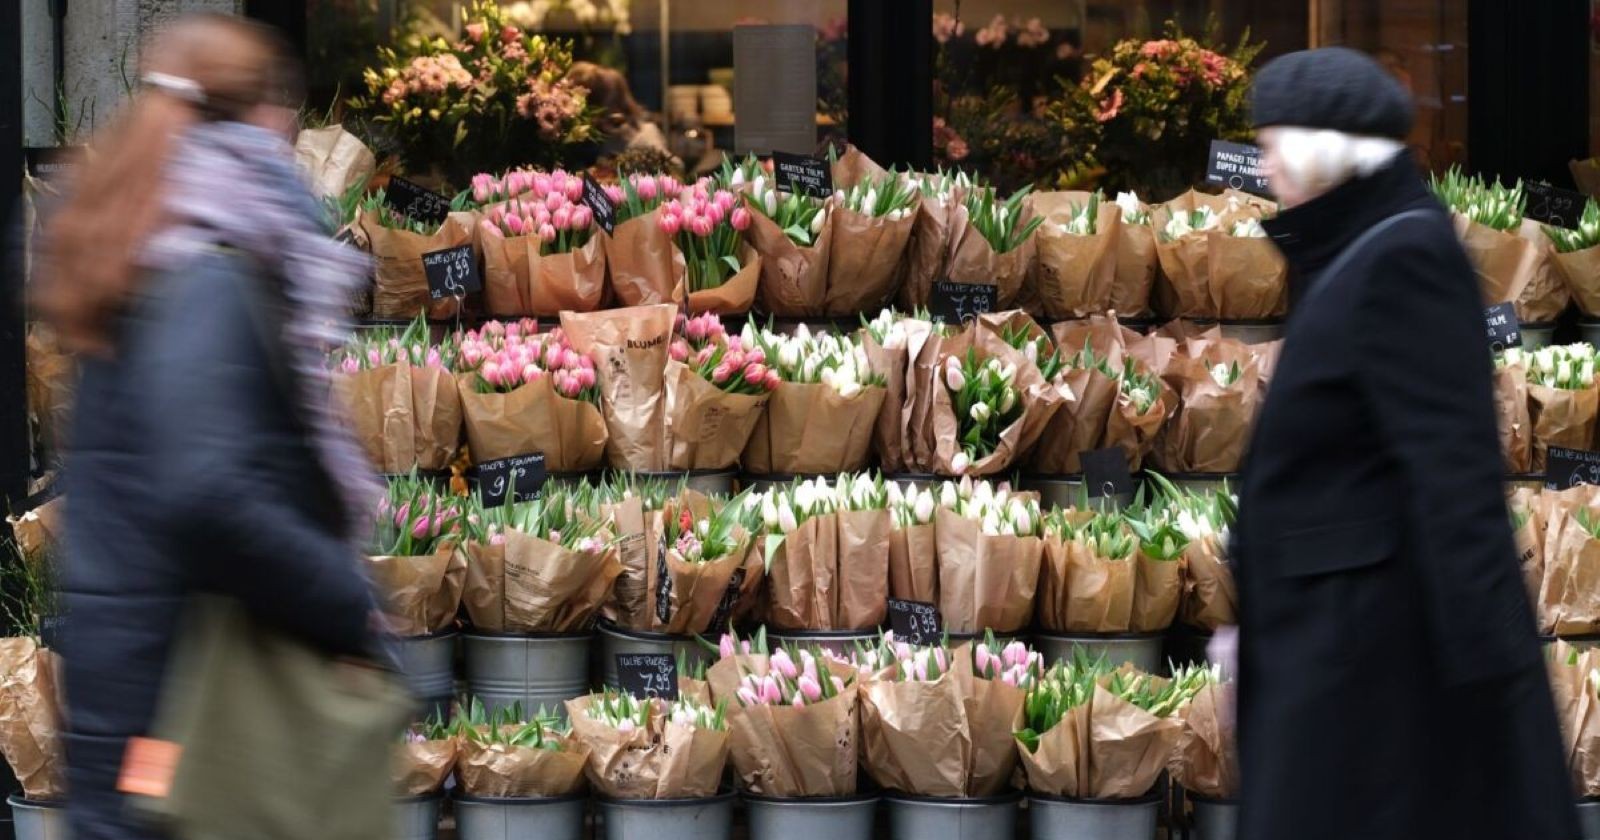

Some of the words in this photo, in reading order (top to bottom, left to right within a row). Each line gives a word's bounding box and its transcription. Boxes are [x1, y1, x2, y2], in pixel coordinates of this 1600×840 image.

[1216, 151, 1245, 164] PAPAGEI
[779, 163, 805, 174] GARTEN
[806, 167, 825, 179] TULPE
[1215, 160, 1238, 173] SUPER
